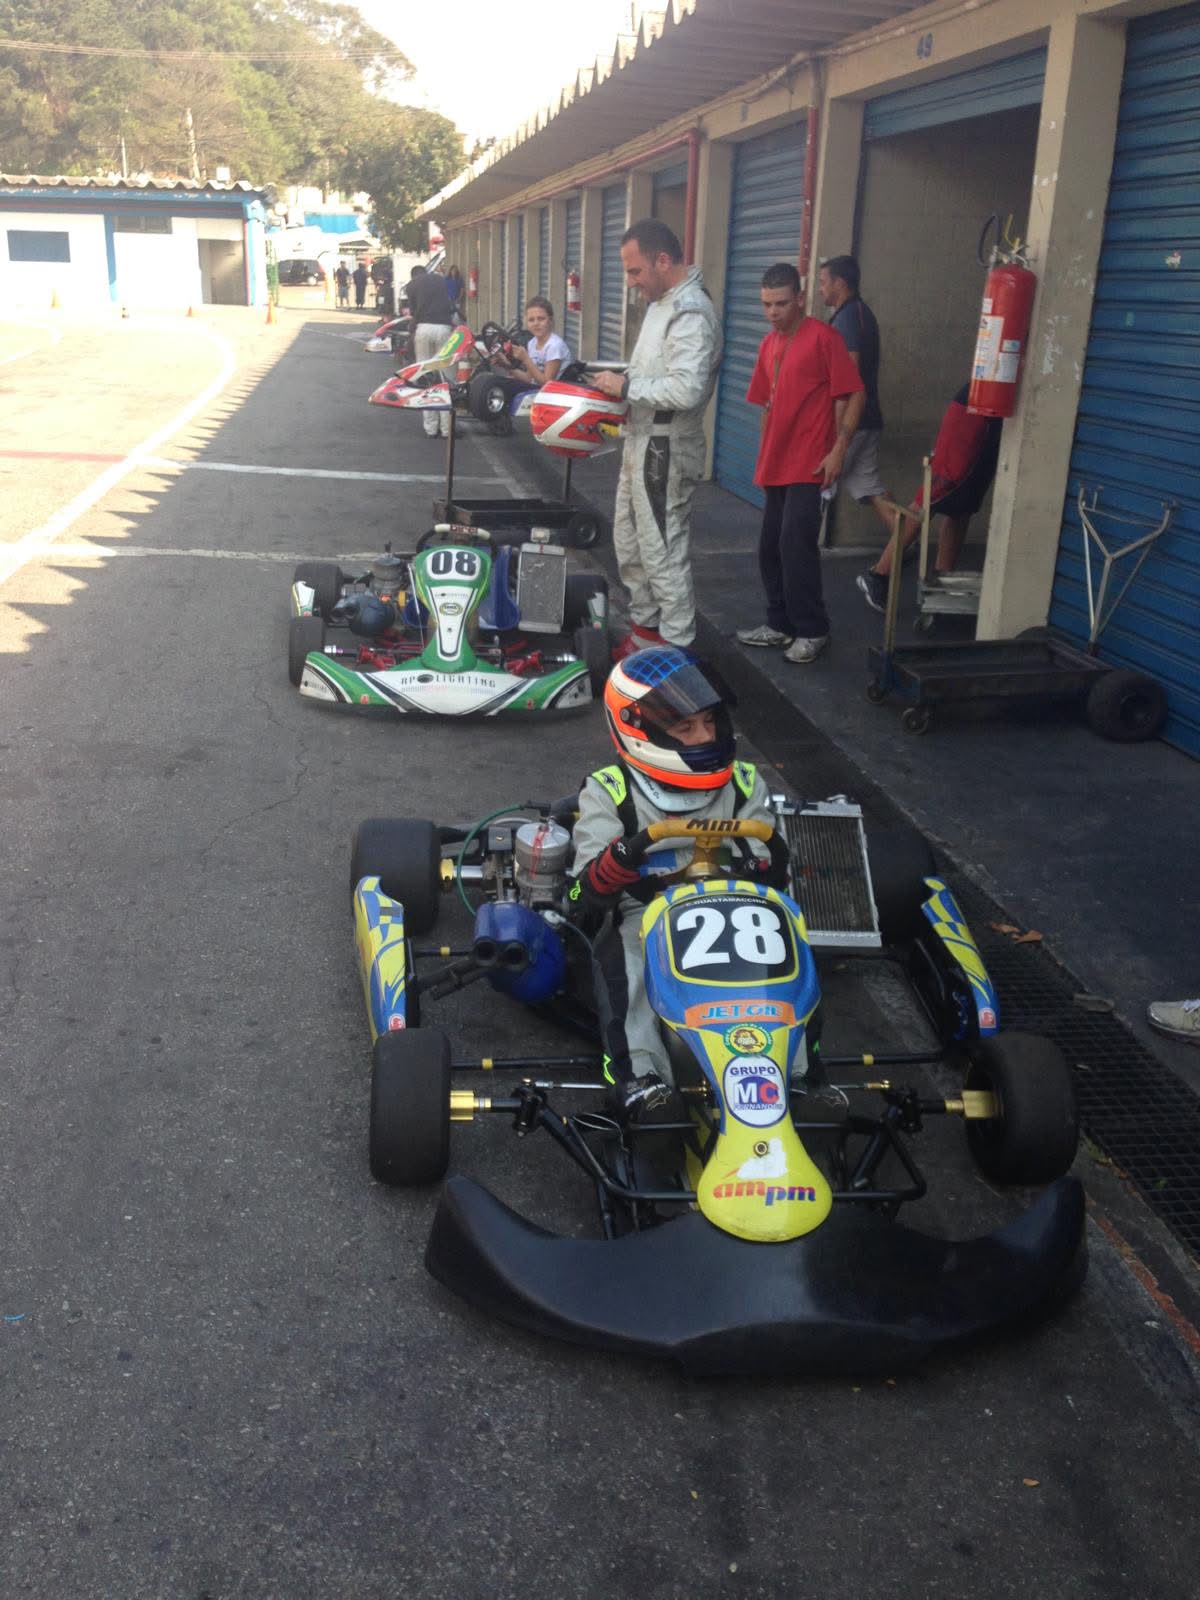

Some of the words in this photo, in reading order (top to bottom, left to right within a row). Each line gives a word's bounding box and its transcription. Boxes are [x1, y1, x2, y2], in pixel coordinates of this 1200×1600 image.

[431, 550, 477, 577] 08
[676, 905, 786, 970] 28
[701, 1005, 743, 1019] JET
[730, 1066, 776, 1076] GRUPO
[734, 1081, 779, 1104] MC
